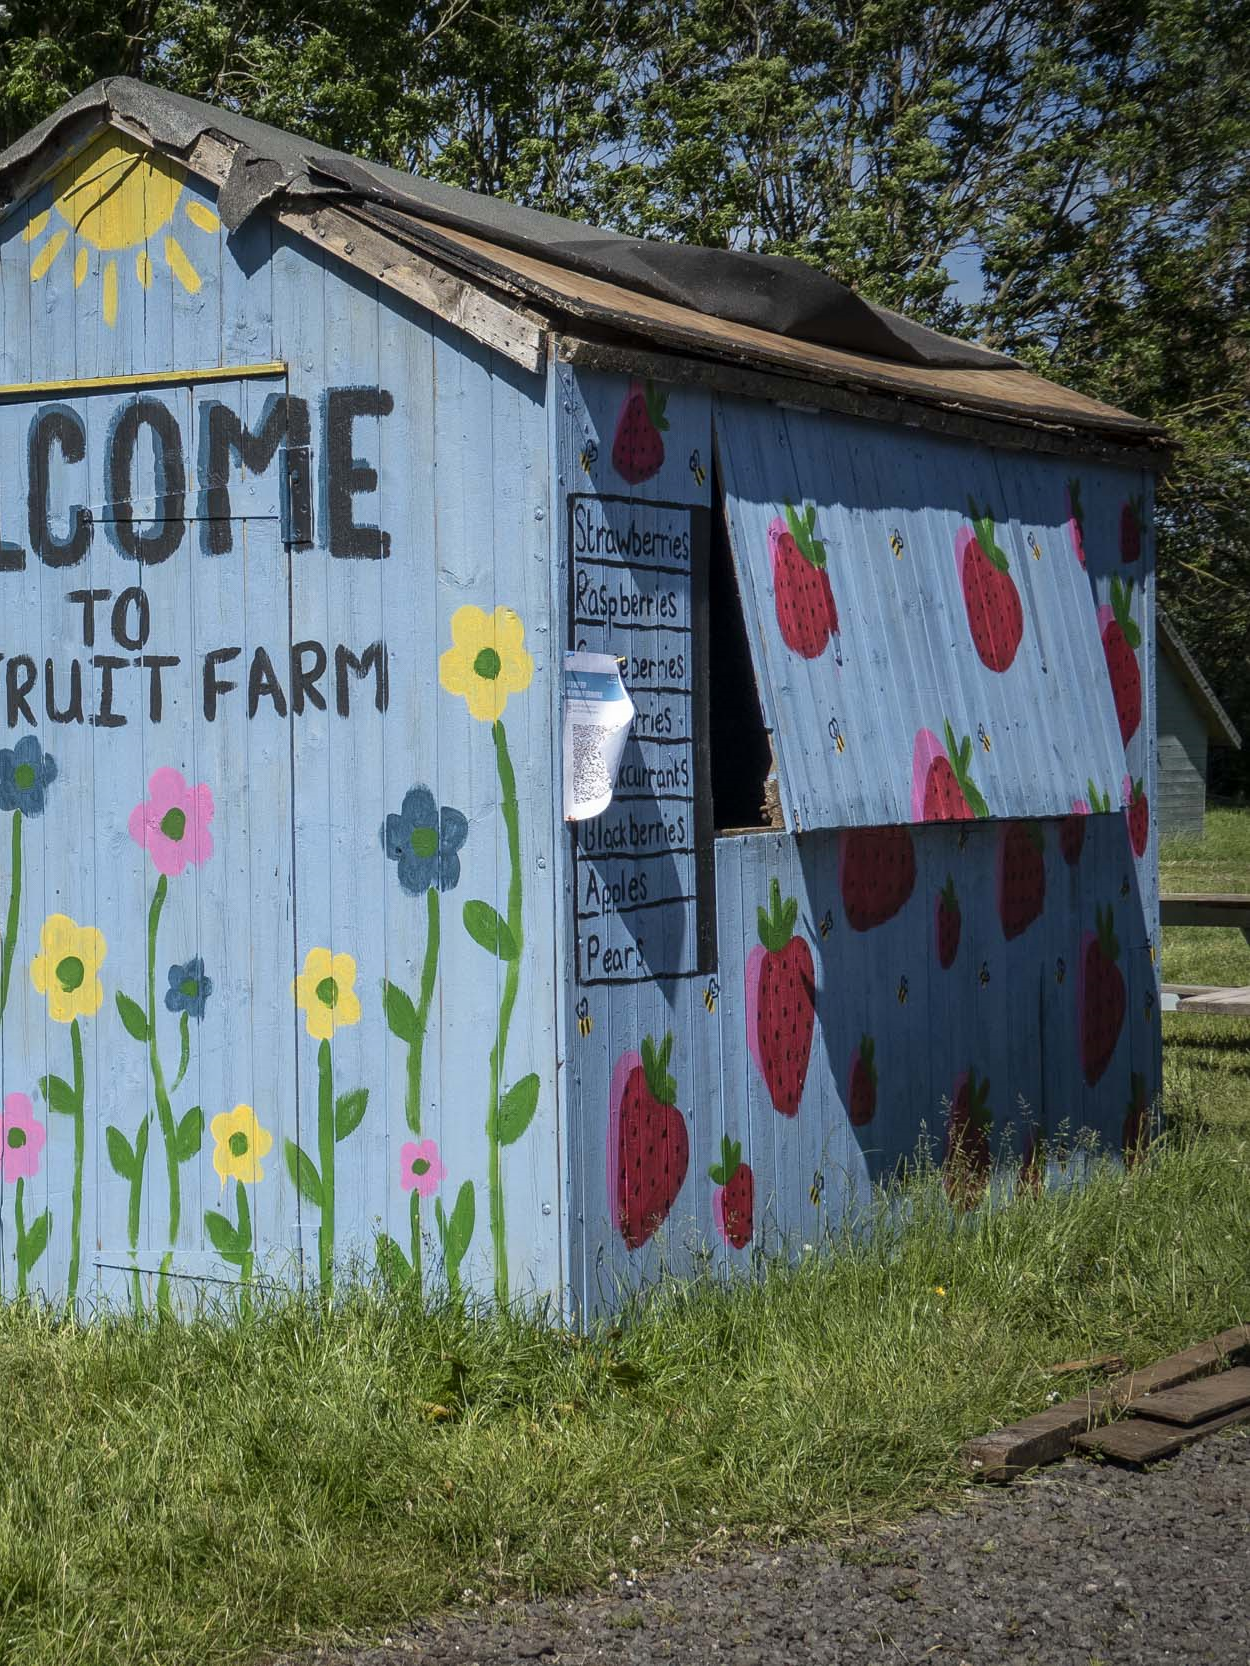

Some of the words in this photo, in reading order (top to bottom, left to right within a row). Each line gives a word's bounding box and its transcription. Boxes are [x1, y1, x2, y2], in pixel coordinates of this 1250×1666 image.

[575, 503, 689, 560] Strawberries
[67, 586, 150, 650] TO
[576, 569, 677, 640] Raspberries
[203, 640, 389, 722] FARM
[614, 758, 689, 789] kcurrants
[584, 811, 684, 850] Blackberries
[586, 869, 648, 917] Apples
[587, 934, 645, 975] Pears
